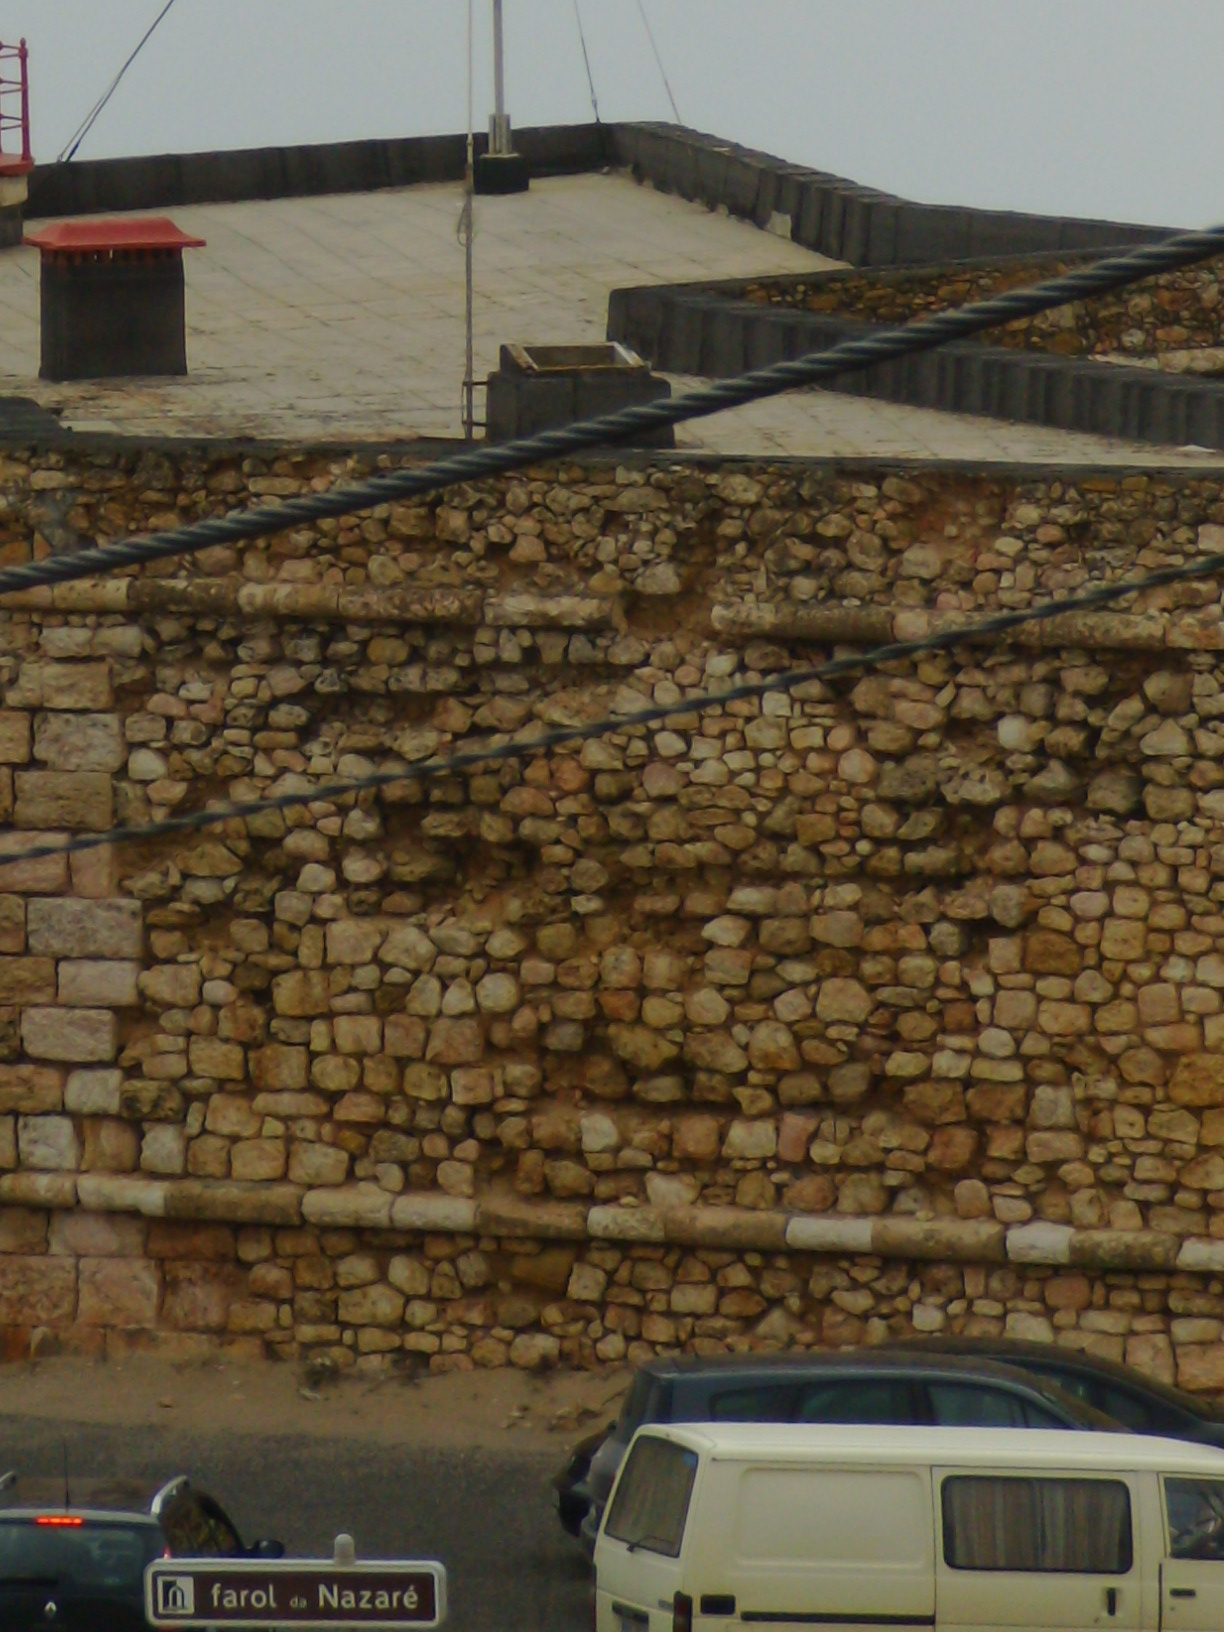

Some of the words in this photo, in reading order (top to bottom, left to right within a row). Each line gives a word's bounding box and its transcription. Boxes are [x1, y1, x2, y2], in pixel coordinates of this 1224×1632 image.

[211, 1583, 277, 1609] farol
[289, 1596, 307, 1609] da
[318, 1583, 418, 1609] Nazaré
